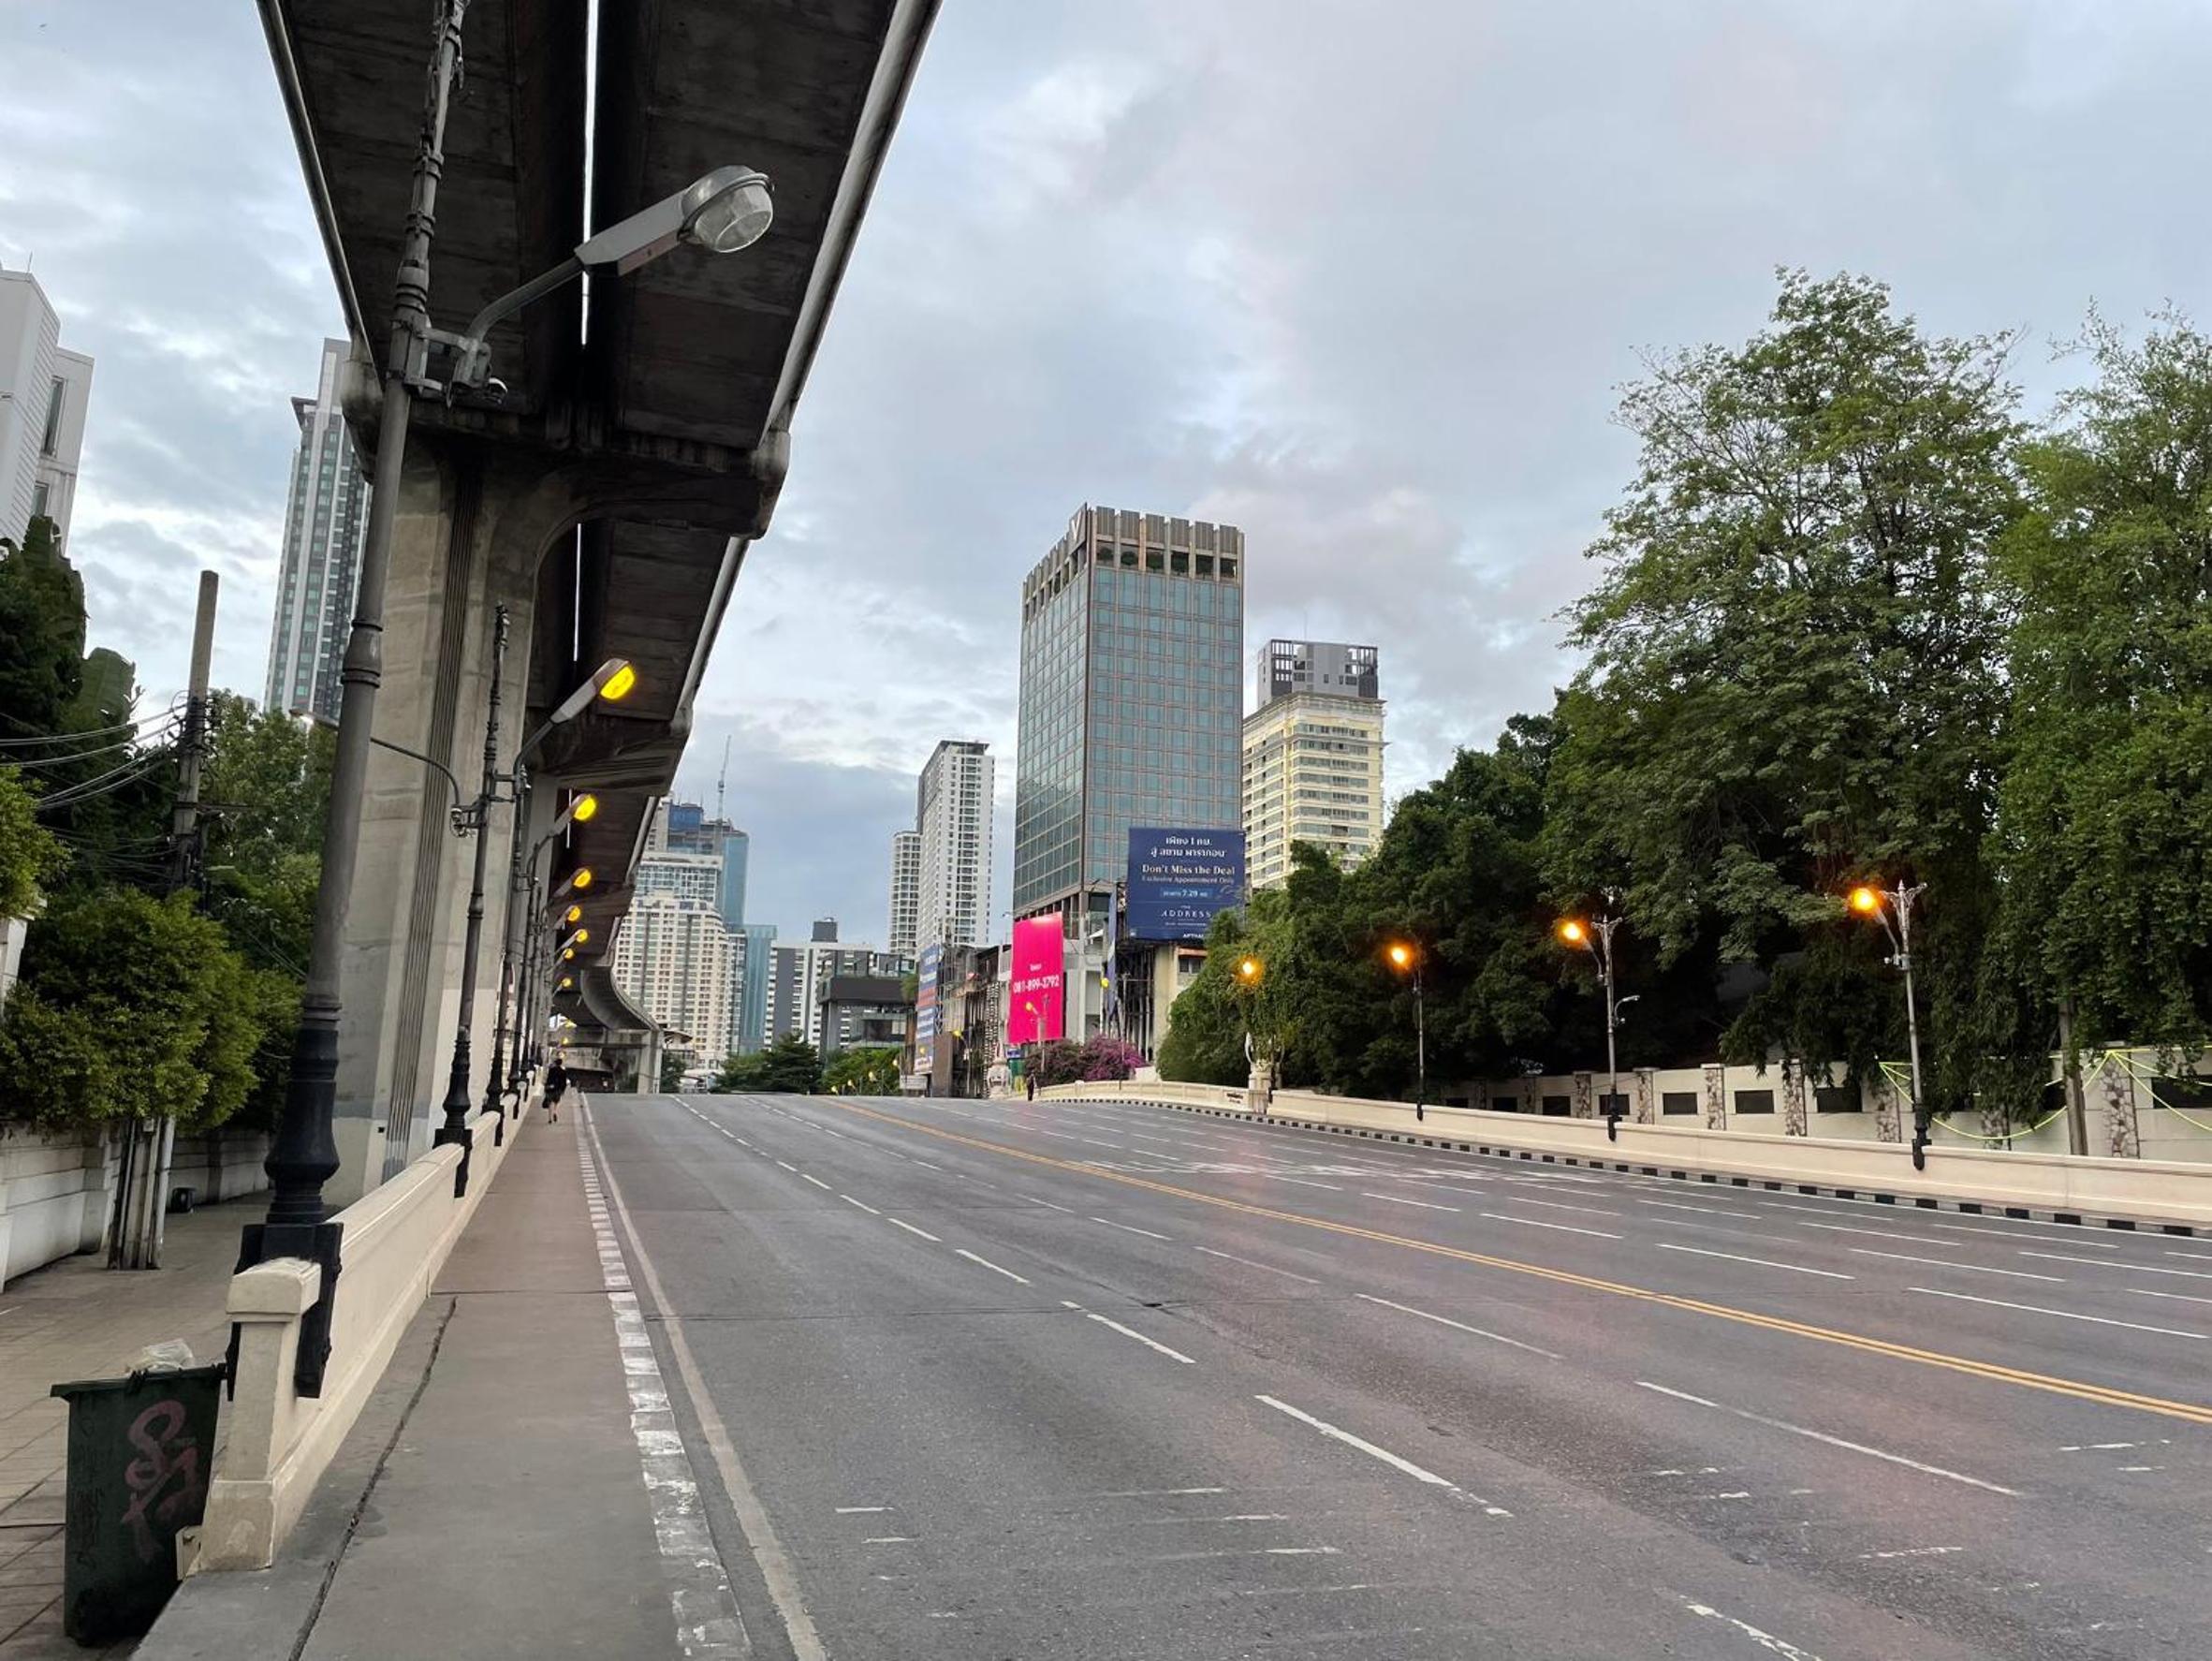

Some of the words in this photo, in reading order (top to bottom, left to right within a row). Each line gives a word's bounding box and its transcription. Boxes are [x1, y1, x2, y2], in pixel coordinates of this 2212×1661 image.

[1142, 864, 1168, 874] Don't
[1171, 865, 1193, 875] Miss
[1195, 865, 1210, 875] the
[1213, 866, 1235, 875] Deal
[1161, 910, 1212, 919] ADDRESS
